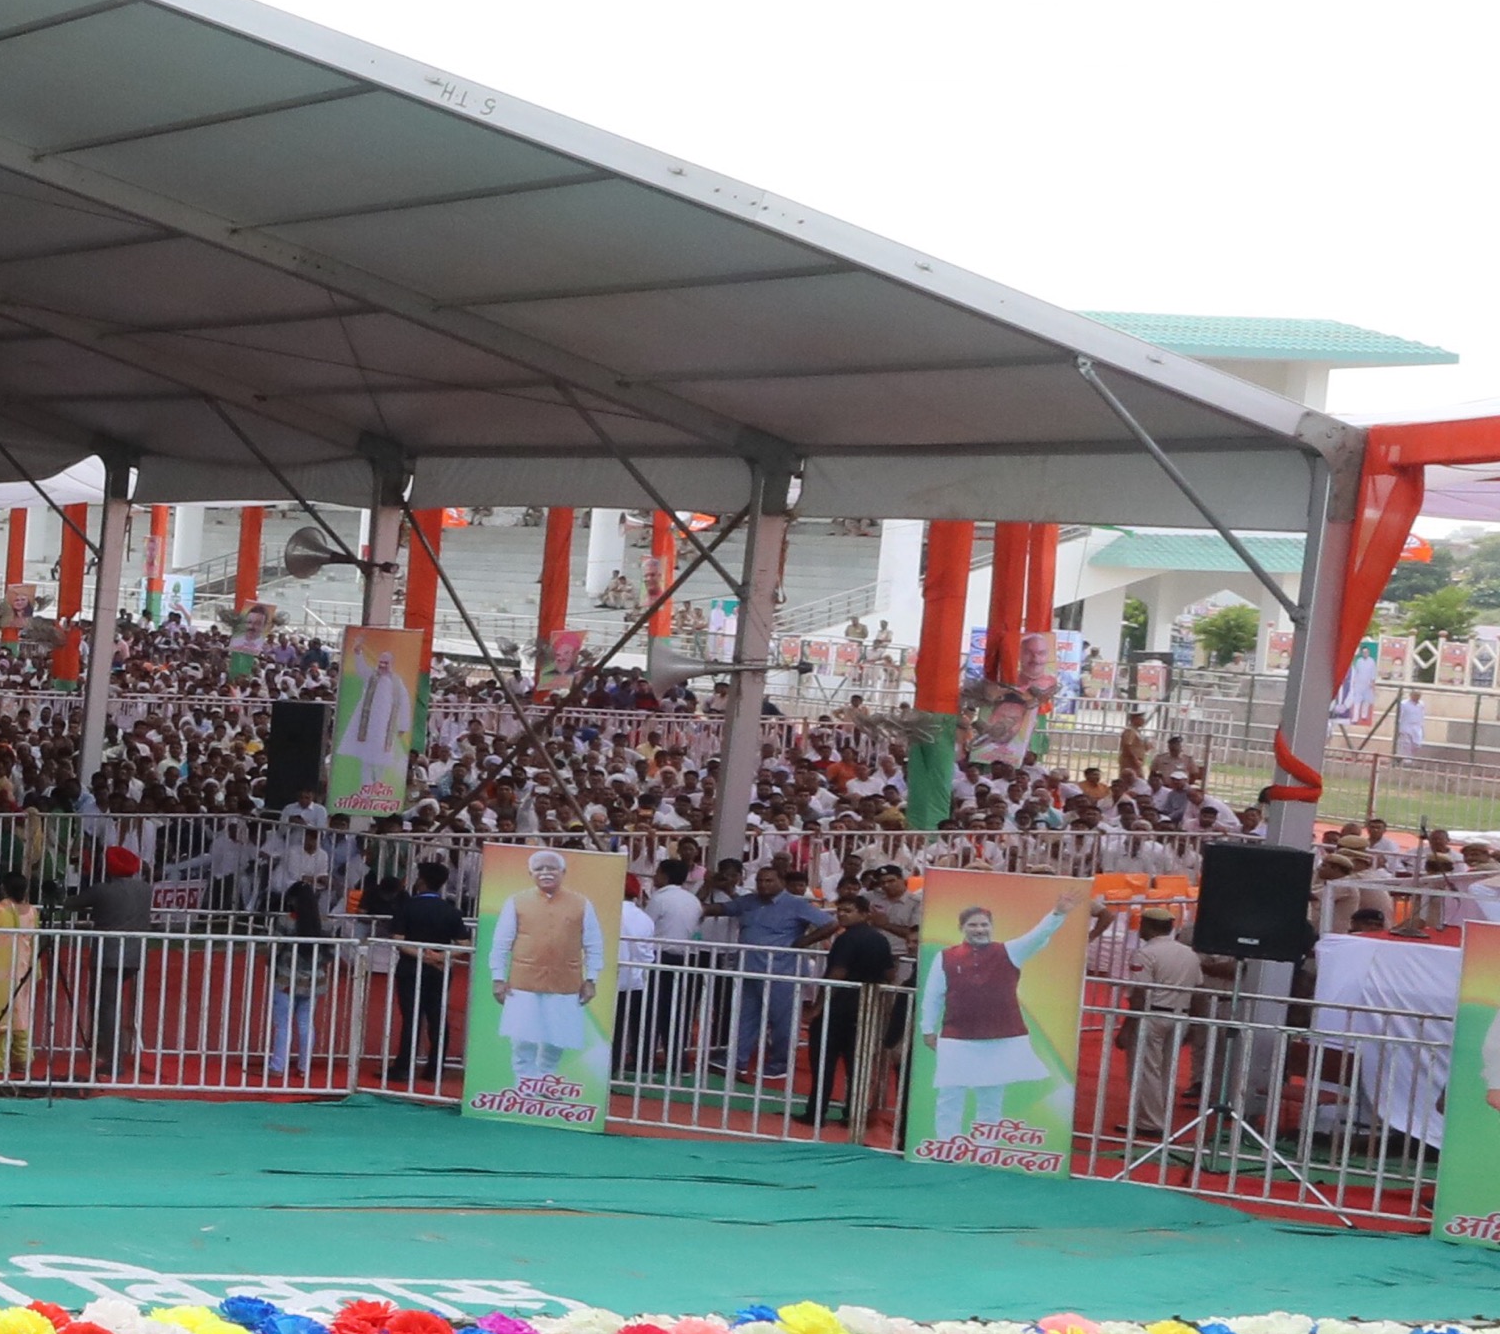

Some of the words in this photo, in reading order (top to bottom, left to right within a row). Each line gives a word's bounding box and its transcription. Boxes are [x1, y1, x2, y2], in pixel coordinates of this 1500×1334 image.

[518, 1074, 583, 1098] हार्दिक
[471, 1088, 597, 1122] अभिनन्दन
[970, 1119, 1046, 1144] हार्दिक
[915, 1135, 1063, 1172] अभिनन्दन
